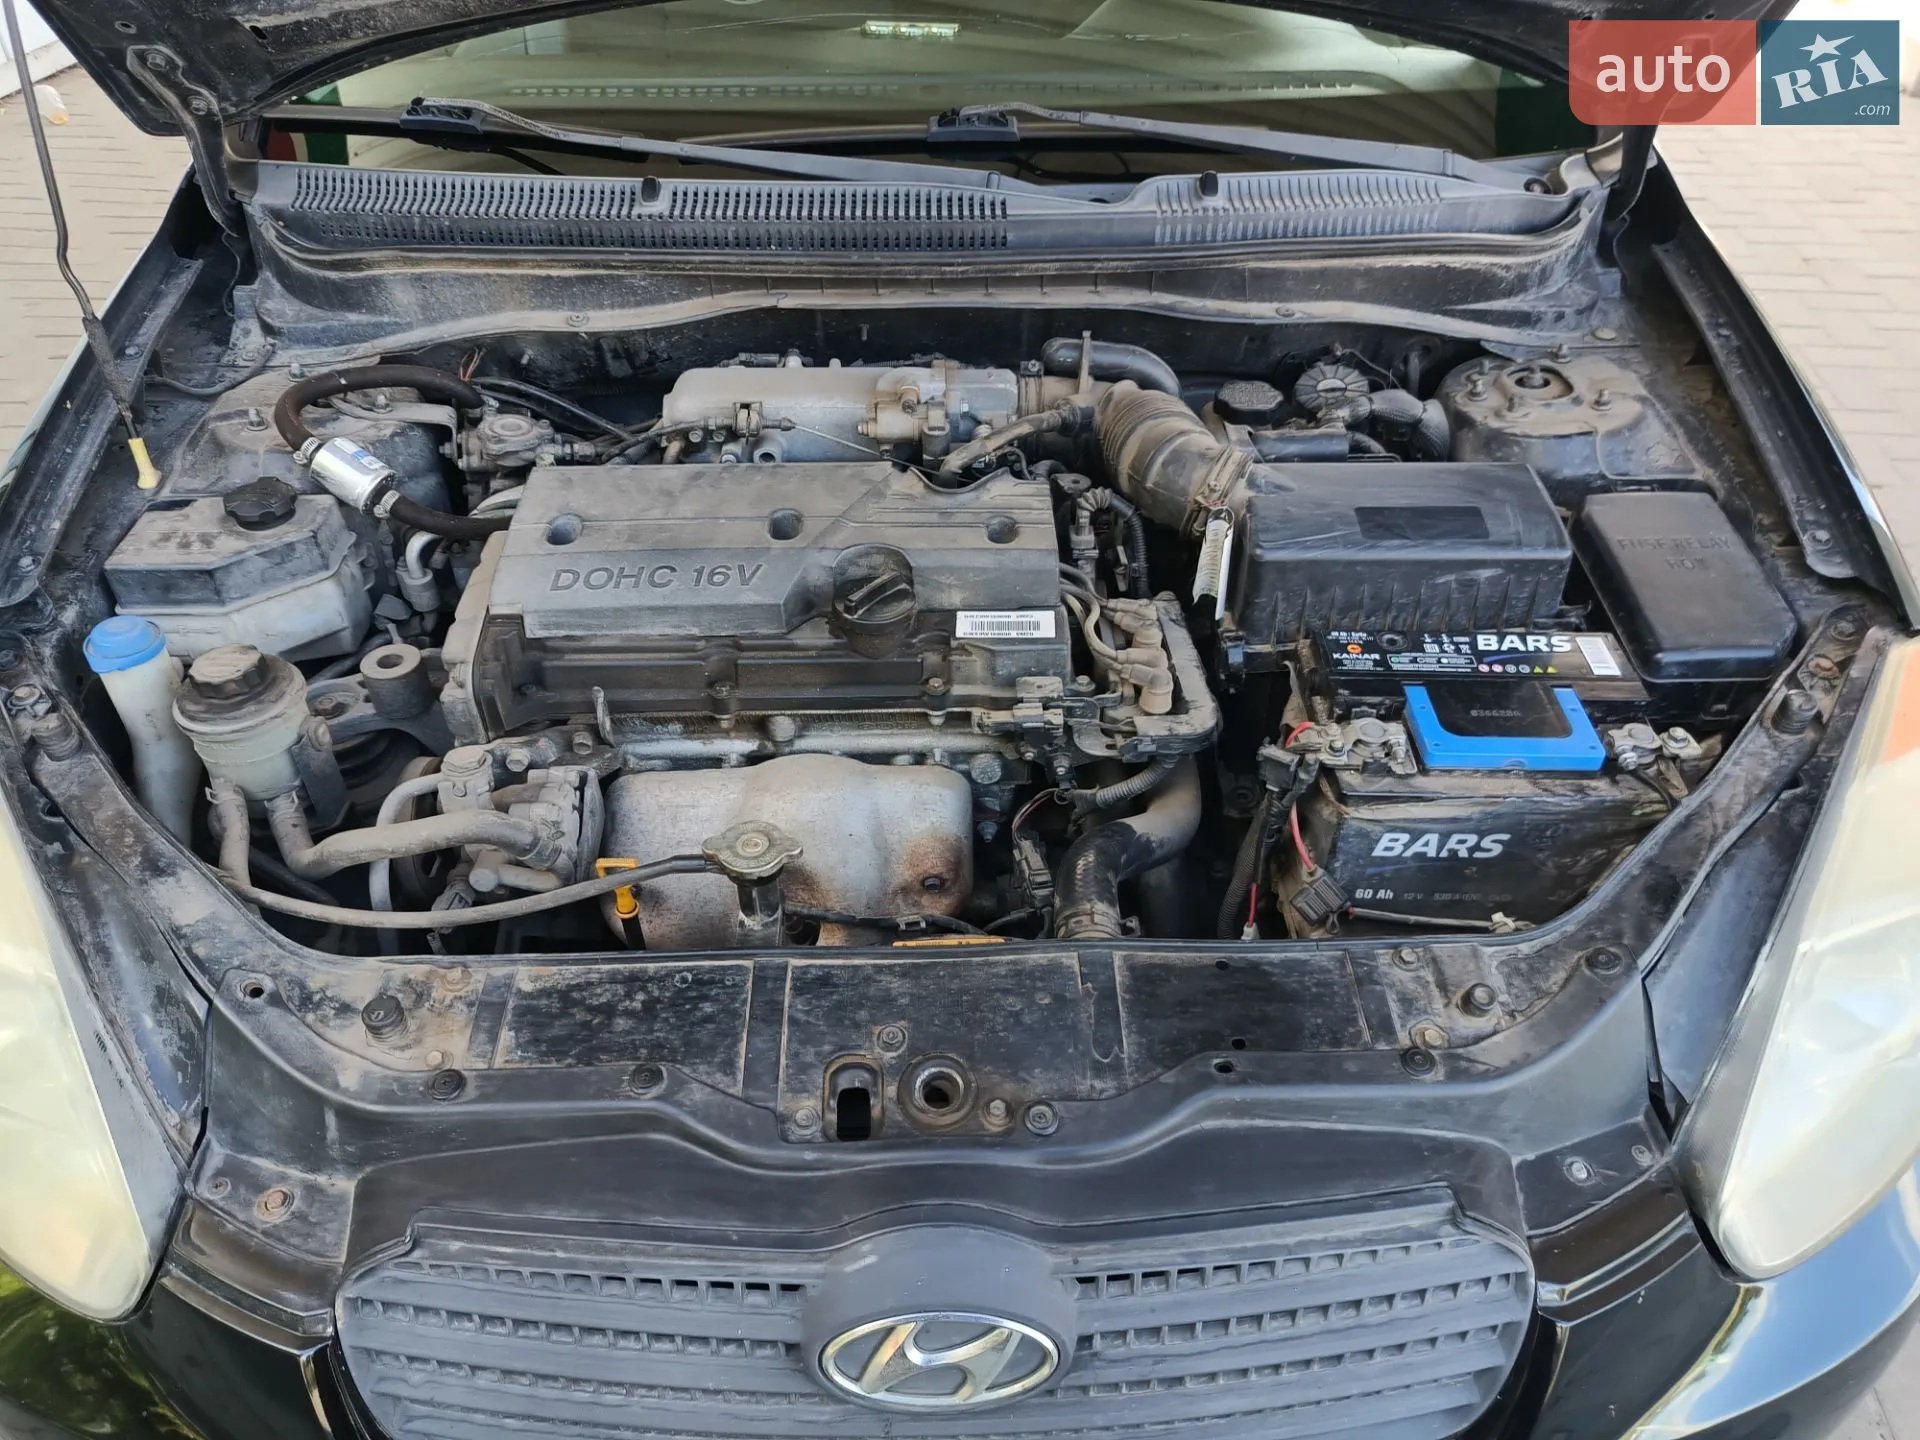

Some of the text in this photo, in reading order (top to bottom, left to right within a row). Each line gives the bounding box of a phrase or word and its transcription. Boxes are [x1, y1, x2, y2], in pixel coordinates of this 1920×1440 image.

[549, 564, 764, 592] DOHC 16V
[1476, 634, 1573, 653] BARS
[1332, 652, 1381, 661] KAINAR
[1371, 832, 1512, 859] BARS
[1355, 888, 1374, 900] 60
[1376, 888, 1394, 900] Ah
